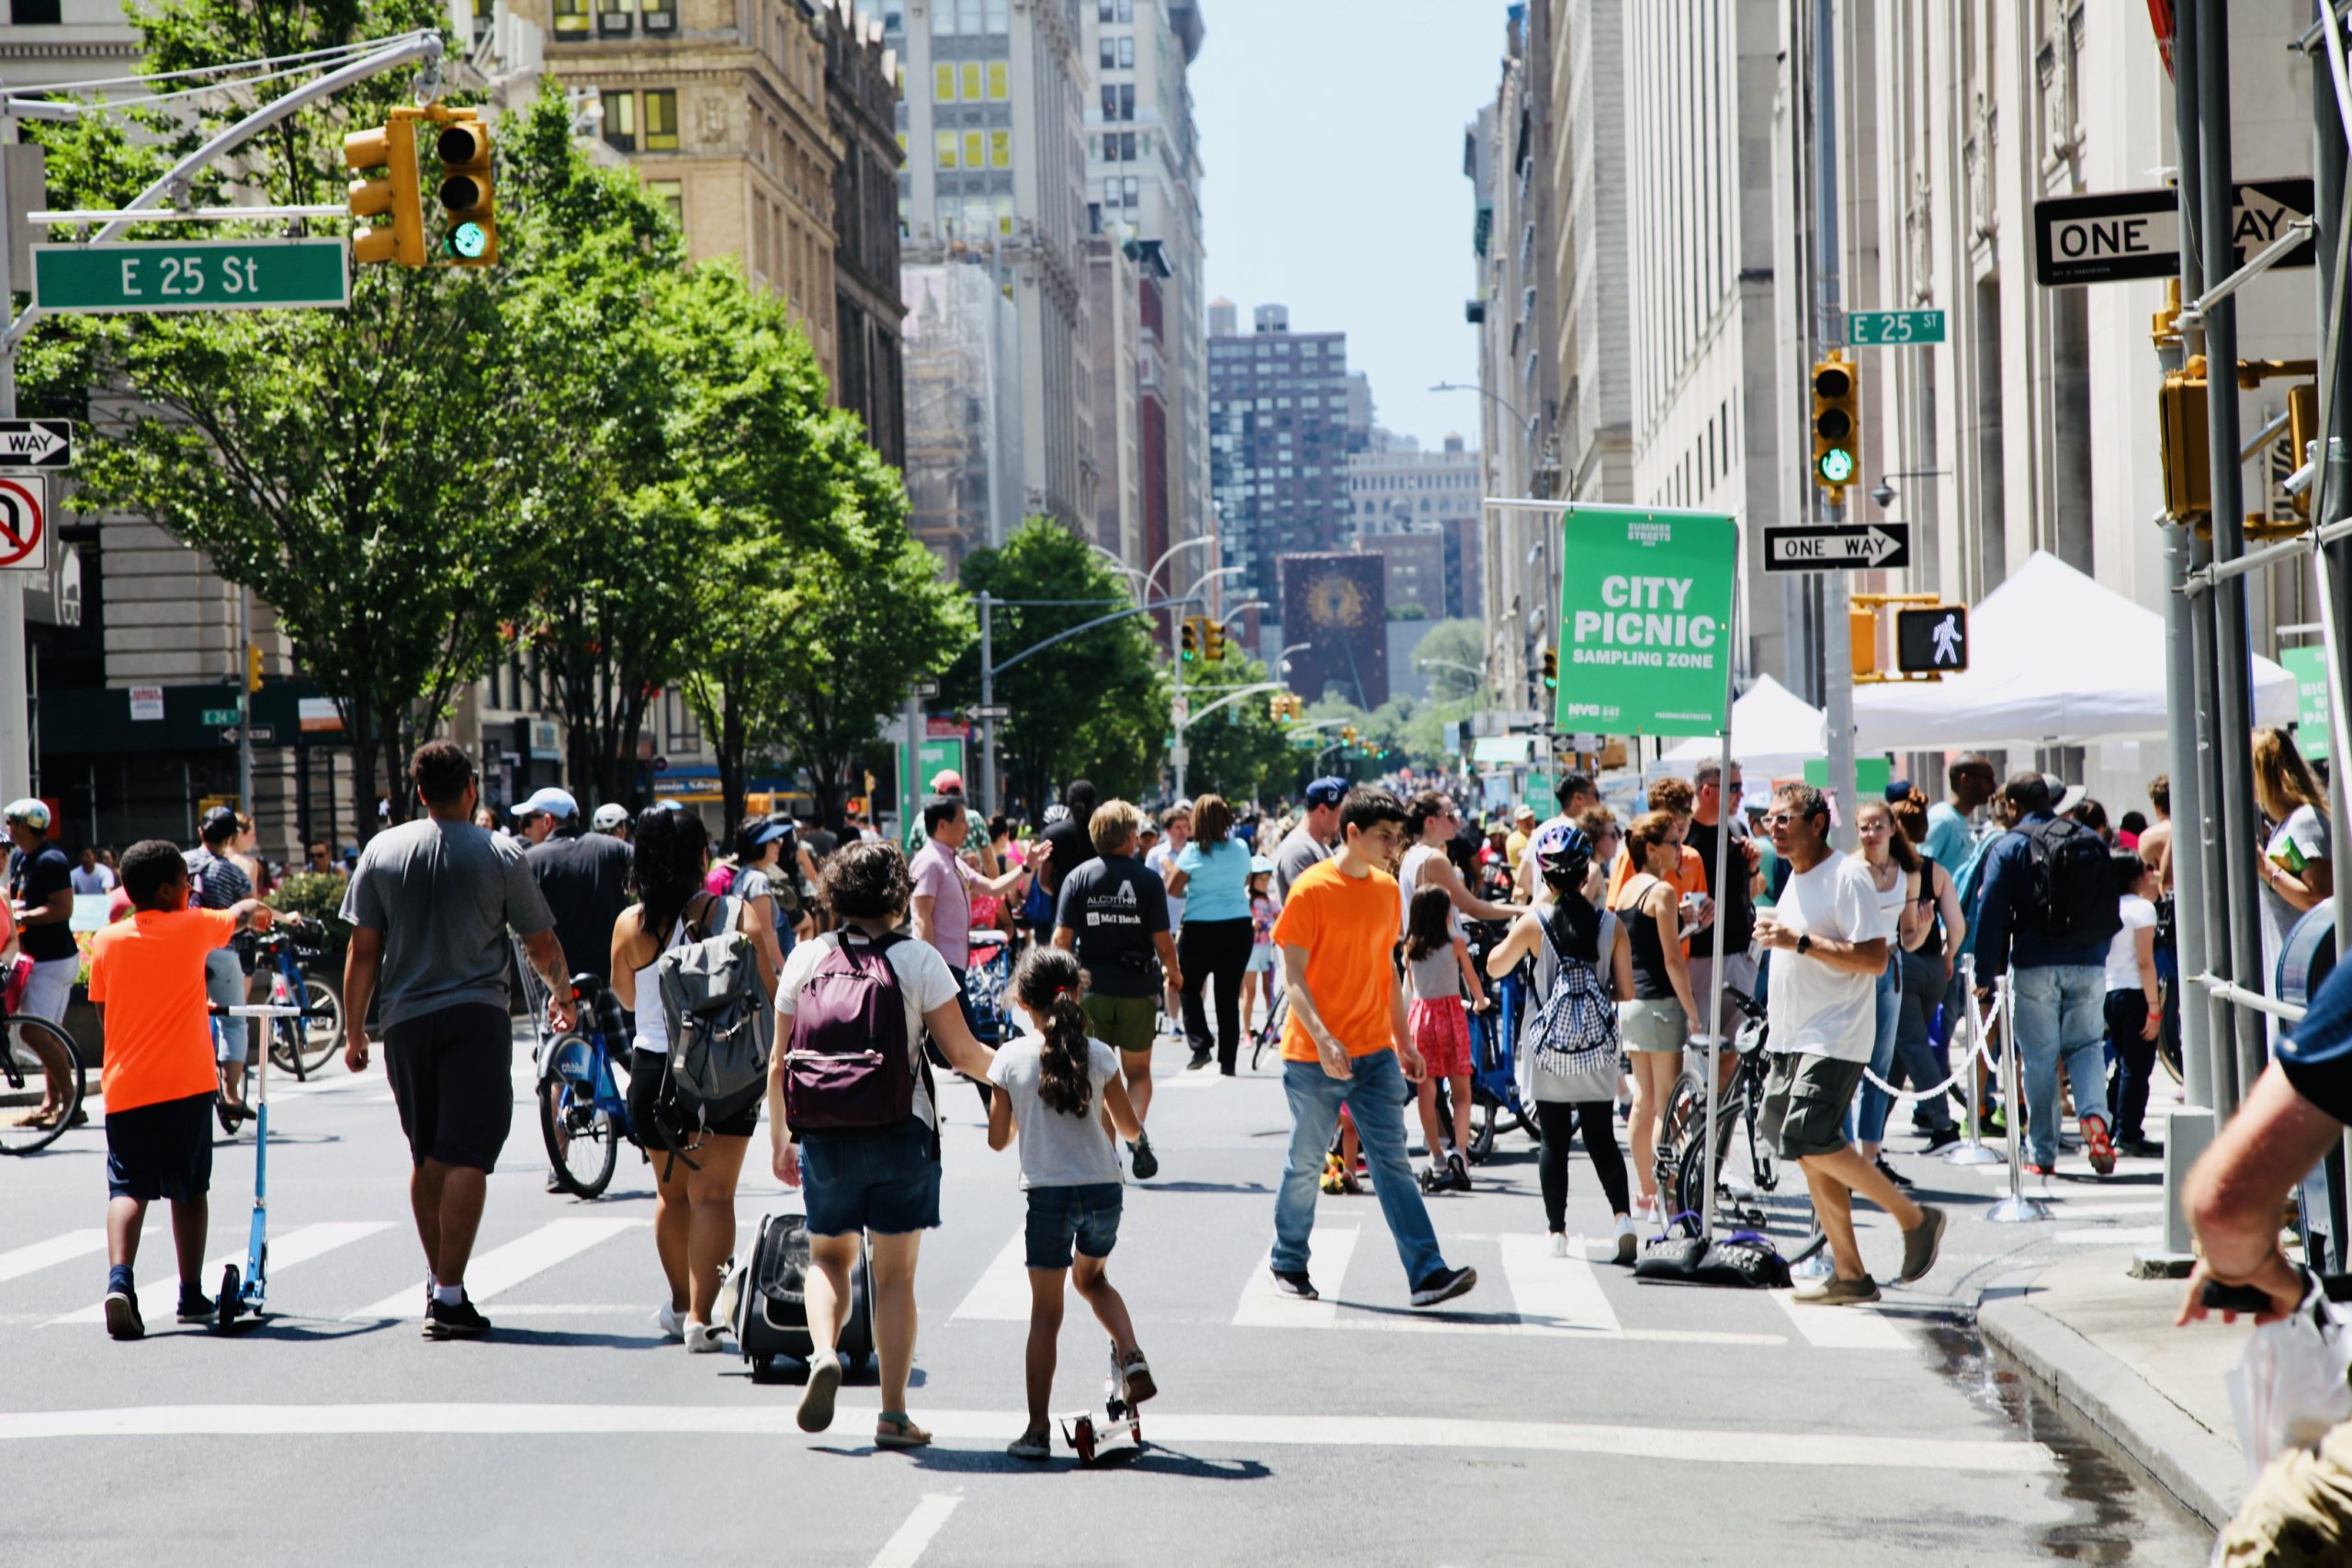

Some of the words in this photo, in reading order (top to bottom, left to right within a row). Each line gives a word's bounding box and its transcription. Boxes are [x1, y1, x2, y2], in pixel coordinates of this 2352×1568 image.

[2059, 219, 2150, 258] ONE
[2233, 207, 2286, 243] AY
[121, 258, 142, 296] E
[160, 256, 205, 296] 25
[221, 255, 259, 294] St
[1854, 319, 1868, 342] E
[1880, 314, 1913, 342] 25
[1922, 311, 1938, 329] ST
[8, 434, 52, 452] WAY
[1784, 537, 1826, 558] ONE
[1844, 536, 1887, 556] WAY
[1601, 575, 1694, 610] CITY
[1574, 610, 1716, 648] PICNIC
[1572, 649, 1662, 667] SAMPLING
[1666, 652, 1713, 669] ZONE
[1118, 914, 1141, 924] Bank
